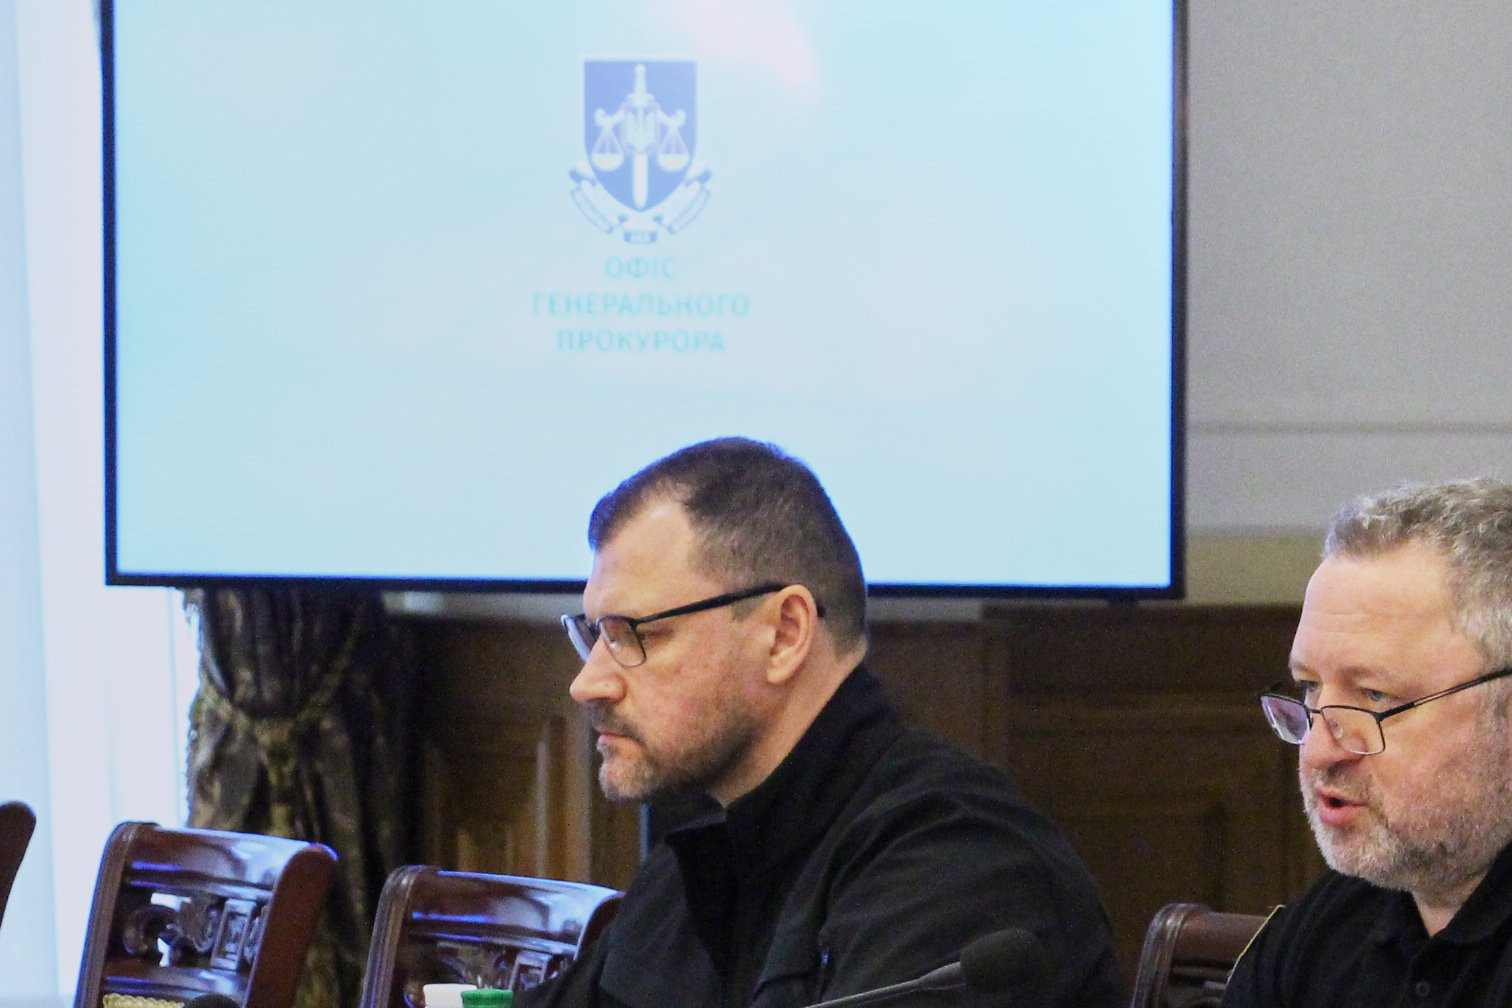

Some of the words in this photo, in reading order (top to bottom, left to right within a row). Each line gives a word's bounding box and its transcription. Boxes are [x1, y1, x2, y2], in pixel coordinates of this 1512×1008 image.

[604, 255, 677, 281] ОФІС
[531, 290, 751, 317] ГЕНЕРАЛЬНОГО
[556, 328, 726, 353] ПРОКУРОРА
